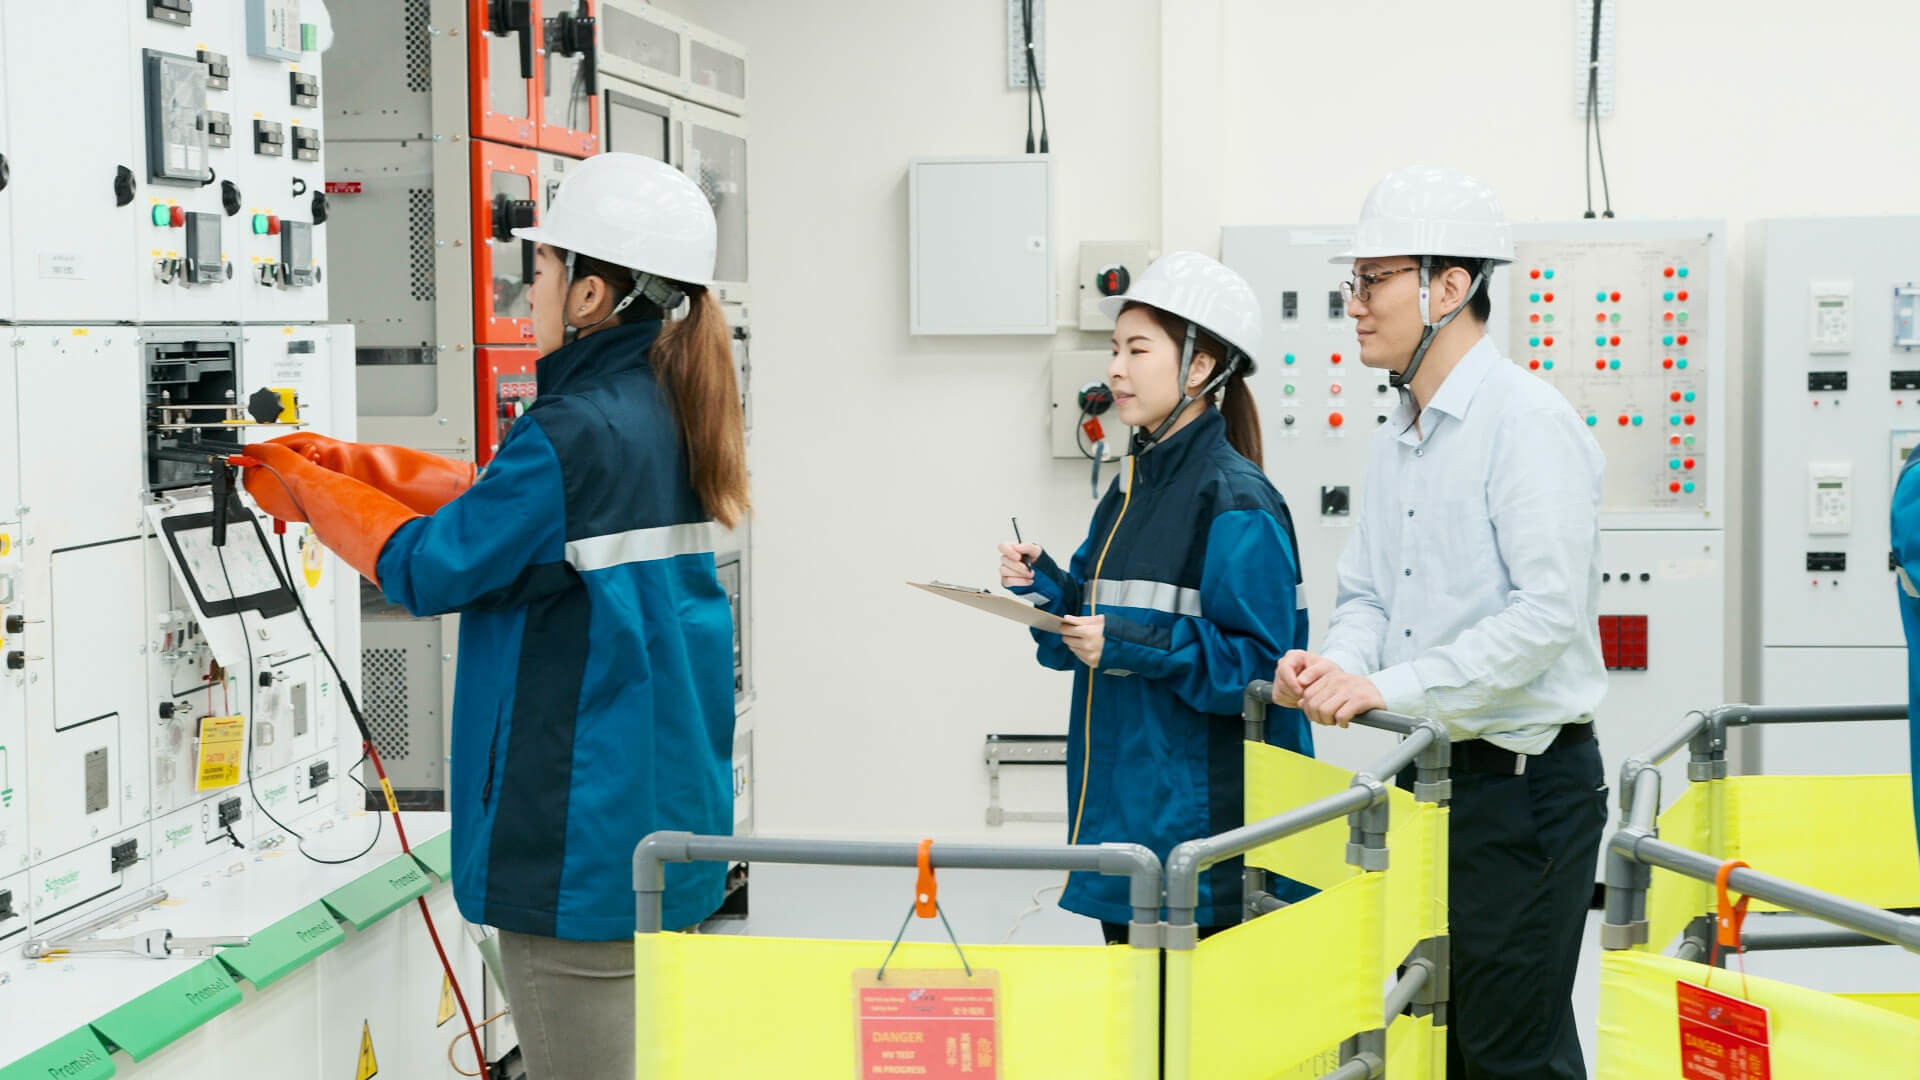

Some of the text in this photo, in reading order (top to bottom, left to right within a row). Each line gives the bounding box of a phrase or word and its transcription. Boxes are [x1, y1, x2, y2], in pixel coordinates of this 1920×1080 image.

[388, 870, 422, 890] Premset
[295, 919, 334, 943] Premset
[184, 976, 230, 1006] Premset
[872, 1031, 924, 1043] DANGER
[47, 1047, 102, 1080] Premset
[895, 1050, 915, 1060] TEST
[884, 1065, 927, 1075] PROGRESS
